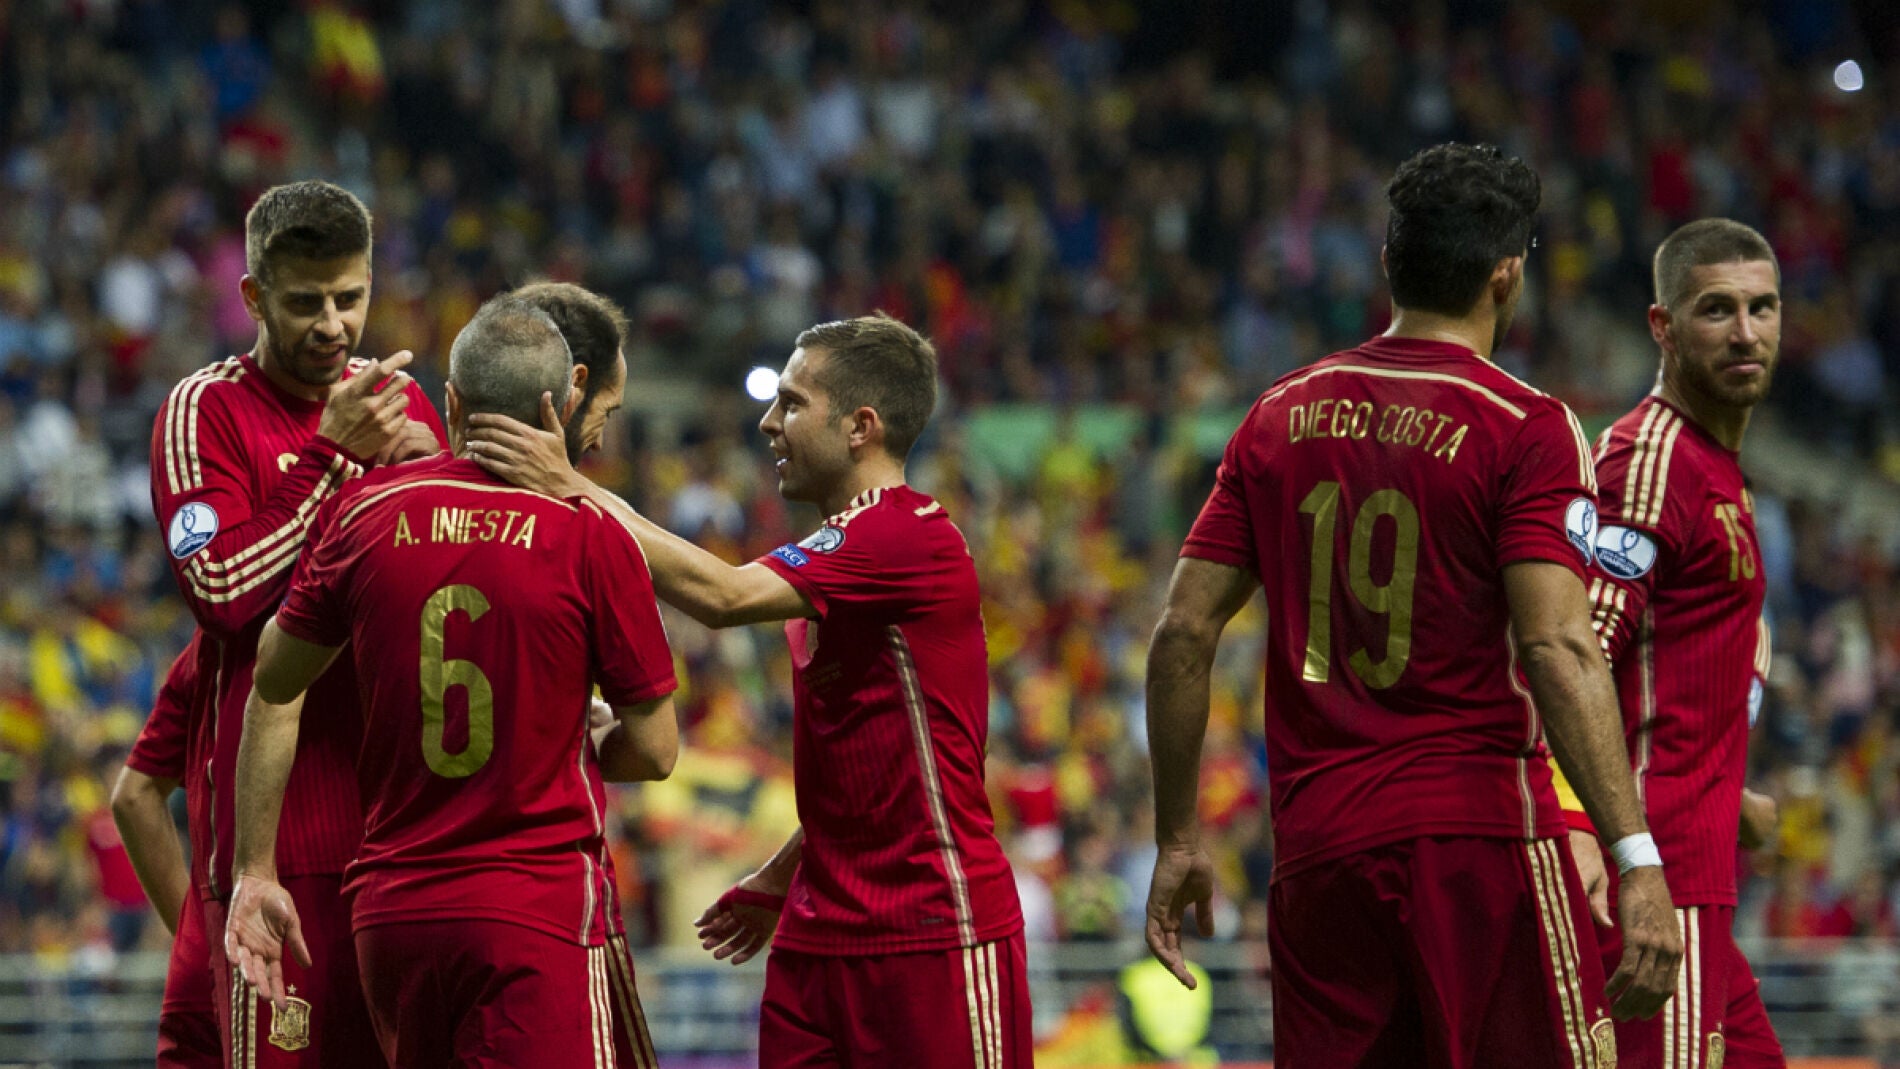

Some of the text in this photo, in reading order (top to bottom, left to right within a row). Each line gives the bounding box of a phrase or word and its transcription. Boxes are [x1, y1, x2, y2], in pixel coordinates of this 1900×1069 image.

[1288, 399, 1469, 465] DIEGO COSTA
[394, 506, 537, 549] A. INIESTA
[1714, 503, 1757, 582] 15
[1299, 480, 1421, 690] 19
[420, 583, 494, 779] 6
